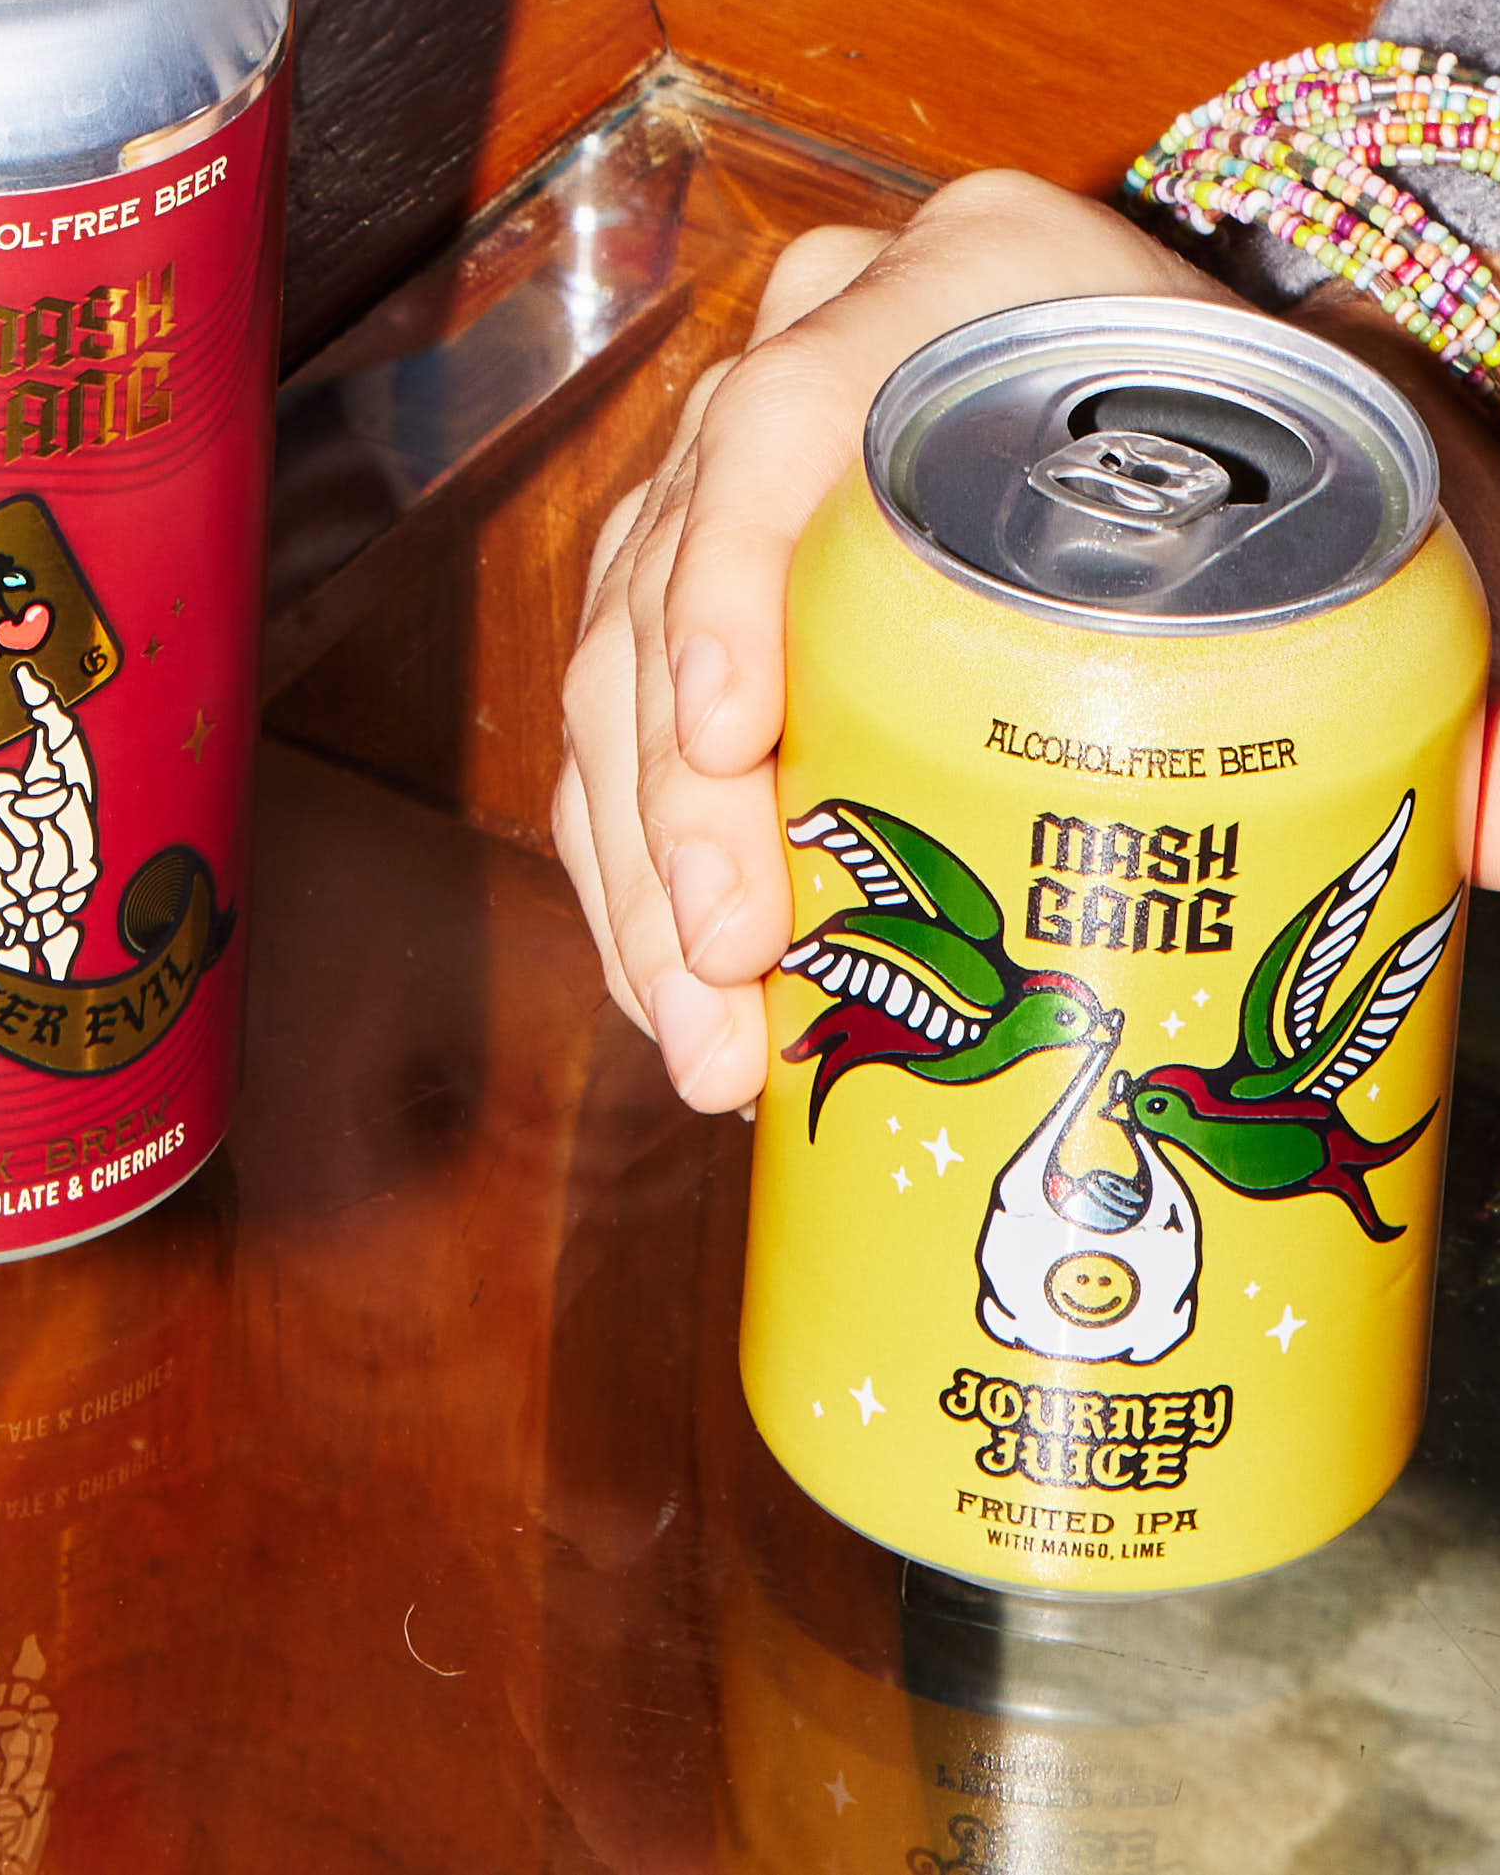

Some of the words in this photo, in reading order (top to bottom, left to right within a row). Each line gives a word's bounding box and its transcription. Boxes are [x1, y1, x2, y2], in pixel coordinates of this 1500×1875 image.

[153, 155, 228, 217] BEER
[1220, 737, 1299, 777] BEER
[1030, 811, 1241, 886] MASH
[1025, 876, 1237, 955] GANG
[84, 953, 194, 1049] EVIL
[44, 1092, 169, 1176] BREW
[67, 1175, 84, 1201] &
[90, 1122, 186, 1193] CHERRIES
[940, 1369, 1233, 1448] JOURNEY
[976, 1430, 1188, 1491] JUICE
[955, 1489, 1115, 1536] FRUITED
[1134, 1508, 1200, 1535] IPA
[987, 1528, 1034, 1552] WITH
[1041, 1540, 1115, 1562] MANGO,
[1121, 1541, 1166, 1560] LIME
